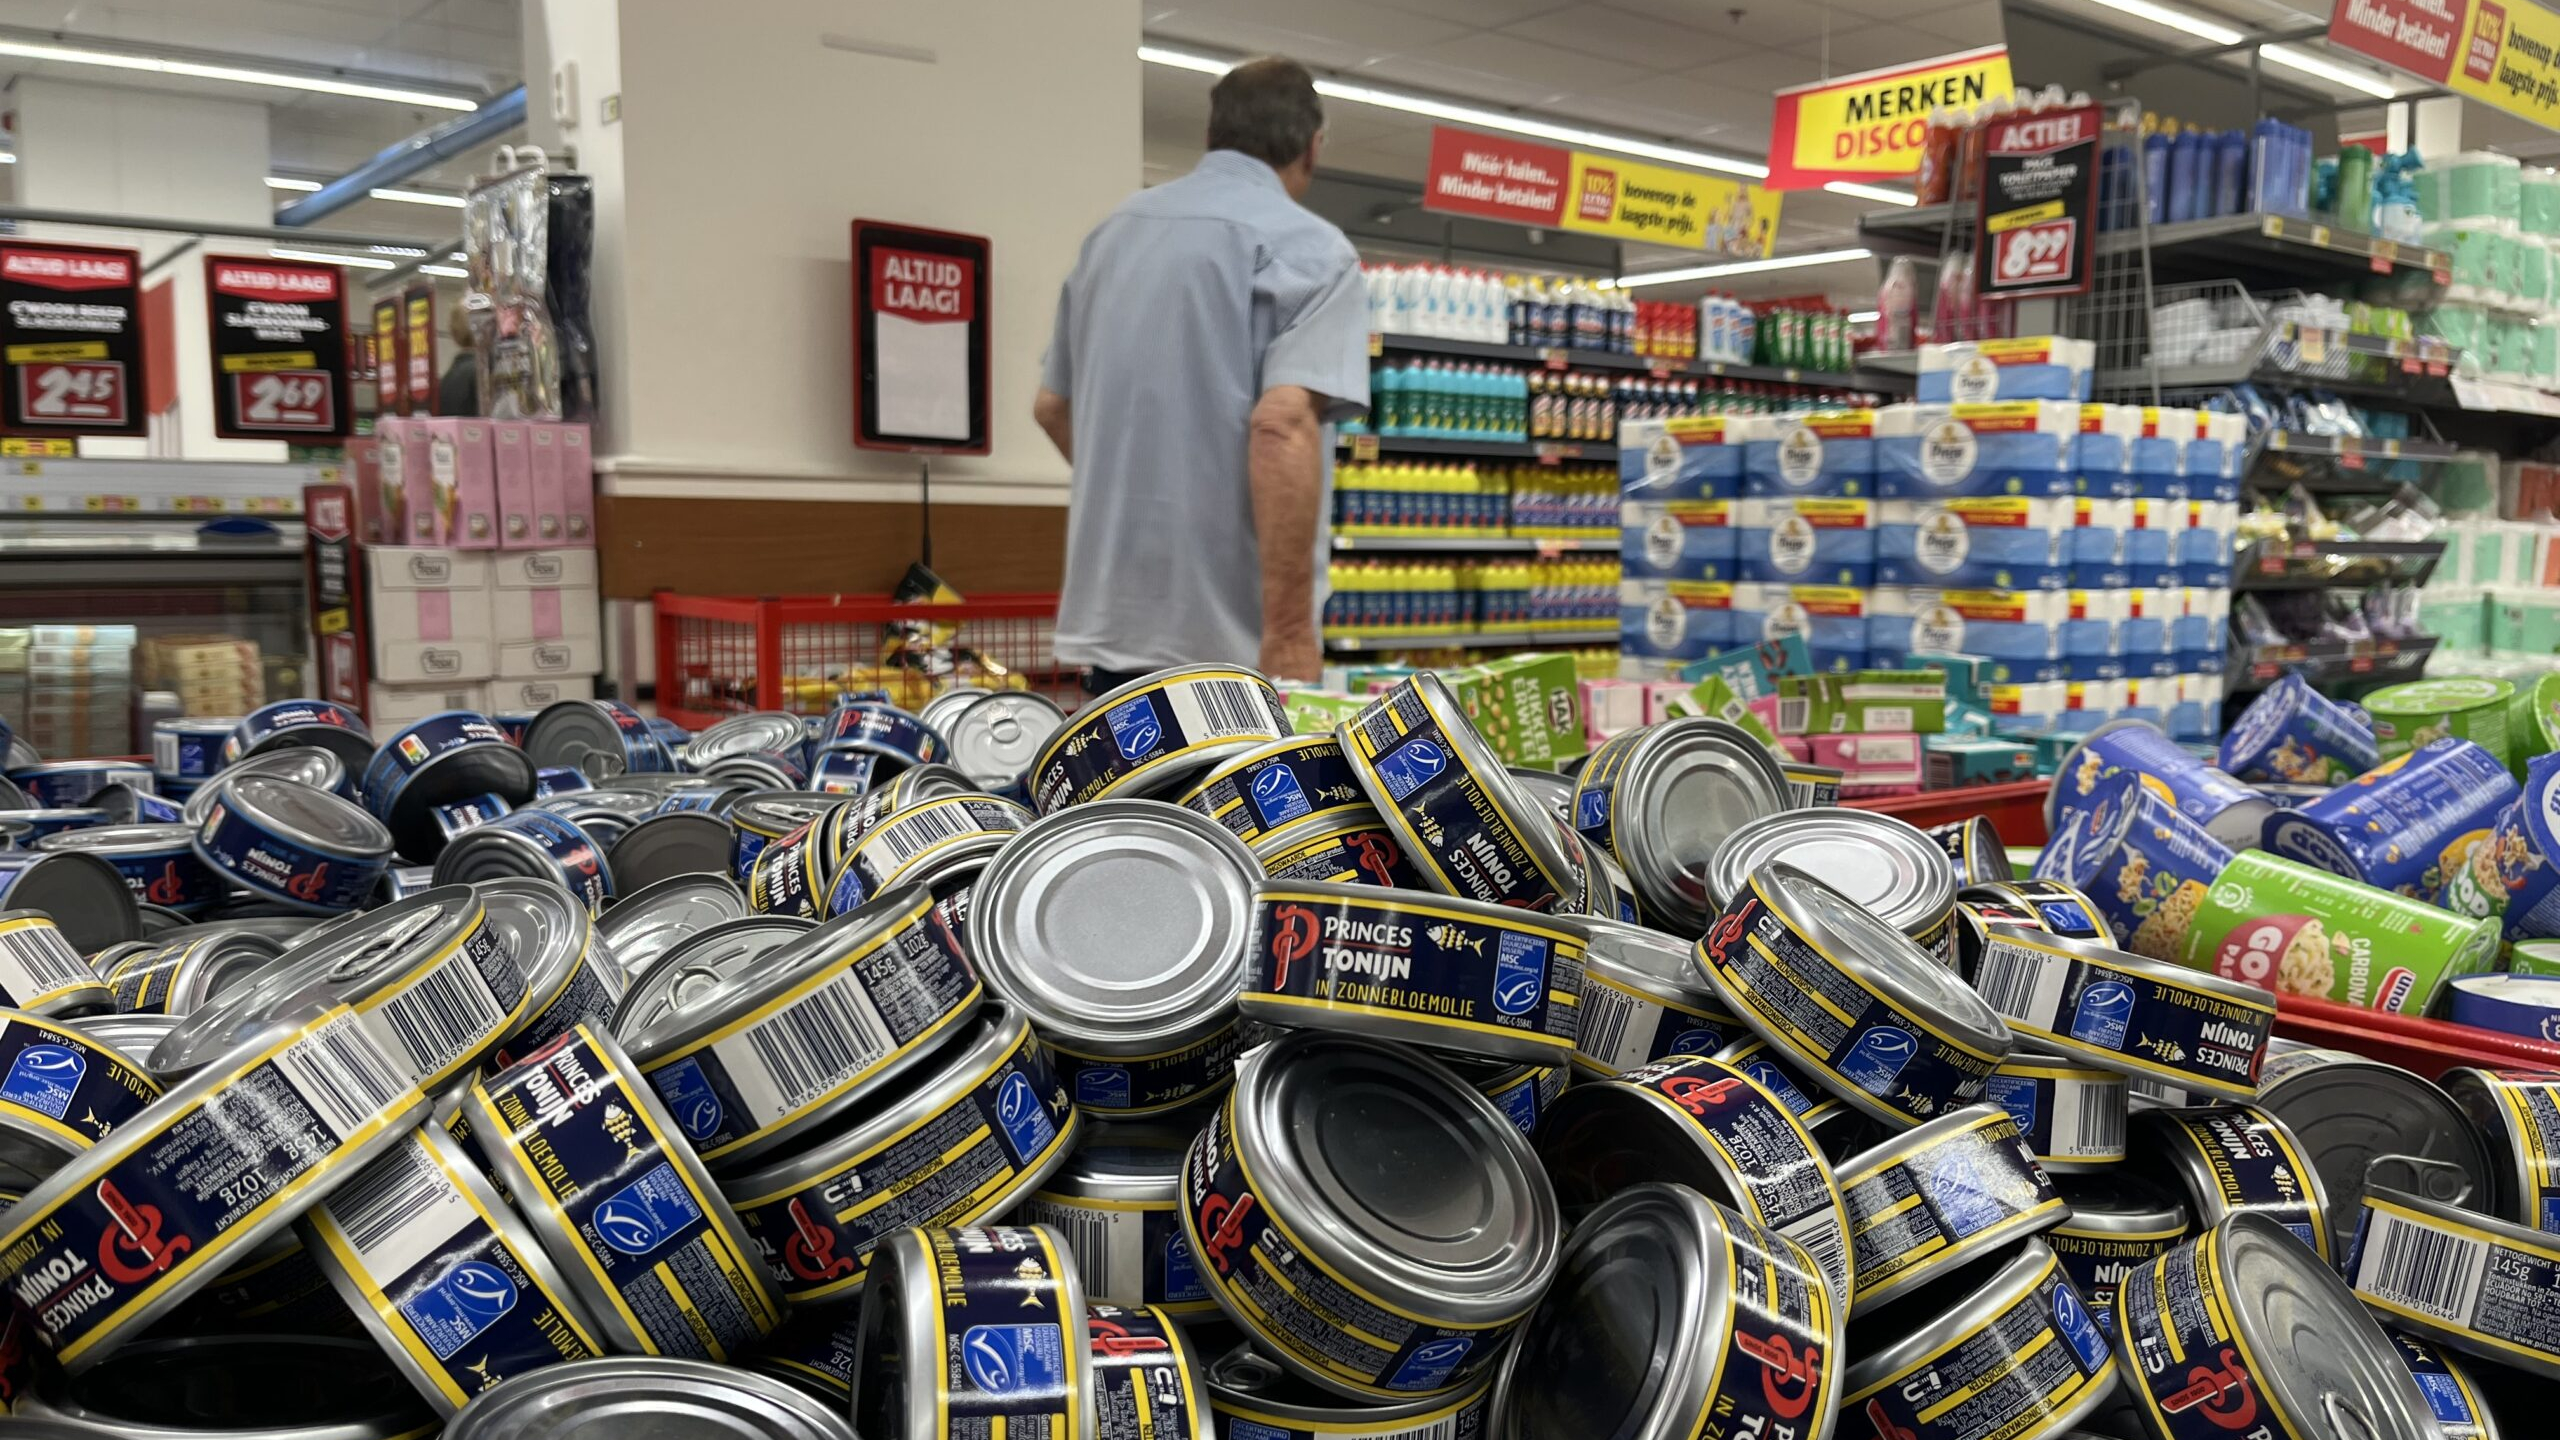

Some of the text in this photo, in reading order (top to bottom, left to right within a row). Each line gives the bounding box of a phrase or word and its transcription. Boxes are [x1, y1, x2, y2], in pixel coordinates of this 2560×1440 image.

[2344, 0, 2451, 61] Minder betalen!
[1846, 72, 1986, 124] MERKEN
[1999, 114, 2083, 150] ACTIE!
[885, 255, 962, 288] ALTIJD
[885, 282, 961, 315] LAAG!
[860, 720, 892, 733] TONIJN
[861, 710, 895, 725] PRINCES
[1113, 719, 1130, 732] MSC
[1551, 689, 1572, 735] HAK
[1203, 728, 1245, 740] 5 016599
[1131, 747, 1166, 768] MSC-C-55841
[1402, 771, 1418, 790] MSC
[1286, 792, 1302, 804] MSC
[1455, 773, 1538, 881] IN ZONNEBLOEMOLIE
[247, 847, 292, 874] TONIJN
[787, 841, 802, 896] PRINCES
[1466, 832, 1518, 894] TONIJN
[769, 851, 787, 907] TONIJN
[1323, 915, 1413, 948] PRINCES
[471, 938, 492, 962] 145g
[862, 935, 930, 986] 145g 102g
[1322, 947, 1412, 982] TONIJN
[1501, 952, 1520, 965] MSC
[2047, 955, 2052, 963] 5
[2094, 967, 2134, 985] MSC-C-55841
[1315, 977, 1475, 1019] IN ZONNEBLOEMOLIE
[1636, 1001, 1644, 1010] 5
[1743, 987, 1796, 1035] VOEDINGSWAARDE
[2152, 985, 2264, 1027] IN ZONNEBLOEMOLIE
[1496, 1014, 1533, 1029] MSC-C-55841
[1887, 1011, 1924, 1038] MSC-C-55841
[2103, 1020, 2124, 1033] MSC
[2200, 1021, 2255, 1052] TONIJN
[37, 1029, 87, 1054] MSC-C-55841
[411, 1018, 499, 1085] 5 016599 010646
[555, 1045, 601, 1105] PRINCES
[1873, 1065, 1895, 1080] MSC
[2195, 1046, 2250, 1076] PRINCES
[45, 1084, 71, 1101] MSC
[525, 1064, 575, 1128] TONIJN
[776, 1048, 885, 1118] 5 016599 010646
[1988, 1093, 2008, 1103] MSC
[1708, 1127, 1747, 1173] UITLEKGEWICHT
[2069, 1145, 2075, 1155] 5
[2203, 1115, 2252, 1161] TONIJN
[2227, 1112, 2274, 1158] PRINCES
[218, 1124, 328, 1207] 145g 102g
[1728, 1134, 1784, 1224] 145g 102g
[638, 1178, 660, 1204] MSC
[654, 1169, 684, 1208] DUURZAME
[660, 1164, 699, 1218] GECERTIFICEERD
[214, 1175, 284, 1233] UITLEKGEWICHT
[1063, 1207, 1120, 1223] 5 016599
[40, 1217, 64, 1243] IN
[579, 1222, 617, 1270] MSC-C-55841
[2153, 1241, 2164, 1255] IN
[2494, 1246, 2552, 1270] NETTOGEWICHT
[15, 1248, 89, 1310] TONIJN
[490, 1244, 531, 1290] MSC-C-55841
[2488, 1270, 2545, 1294] Tonijnstukken in
[2491, 1255, 2531, 1283] 145g
[41, 1273, 115, 1334] PRINCES
[2366, 1282, 2456, 1322] 5 016599 010646
[2484, 1286, 2554, 1312] HOUDBAAR Zie
[2486, 1278, 2547, 1303] ECUADOR 591
[2498, 1297, 2529, 1313] bewaren.
[405, 1304, 450, 1357] GECERTIFICEERD
[423, 1312, 457, 1351] DUURZAME
[438, 1317, 462, 1346] VISSERIJ
[449, 1315, 475, 1340] MSC
[2487, 1309, 2546, 1333] PRINCES LIMITED
[2528, 1331, 2545, 1341] 3001
[1022, 1326, 1036, 1355] MSC
[1262, 1315, 1331, 1367] VOEDINGSWAARDE
[949, 1332, 963, 1391] MSC-C-55841
[1968, 1356, 2019, 1393] INGREDIËNTEN
[2426, 1375, 2439, 1394] MSC
[1715, 1393, 1736, 1418] IN
